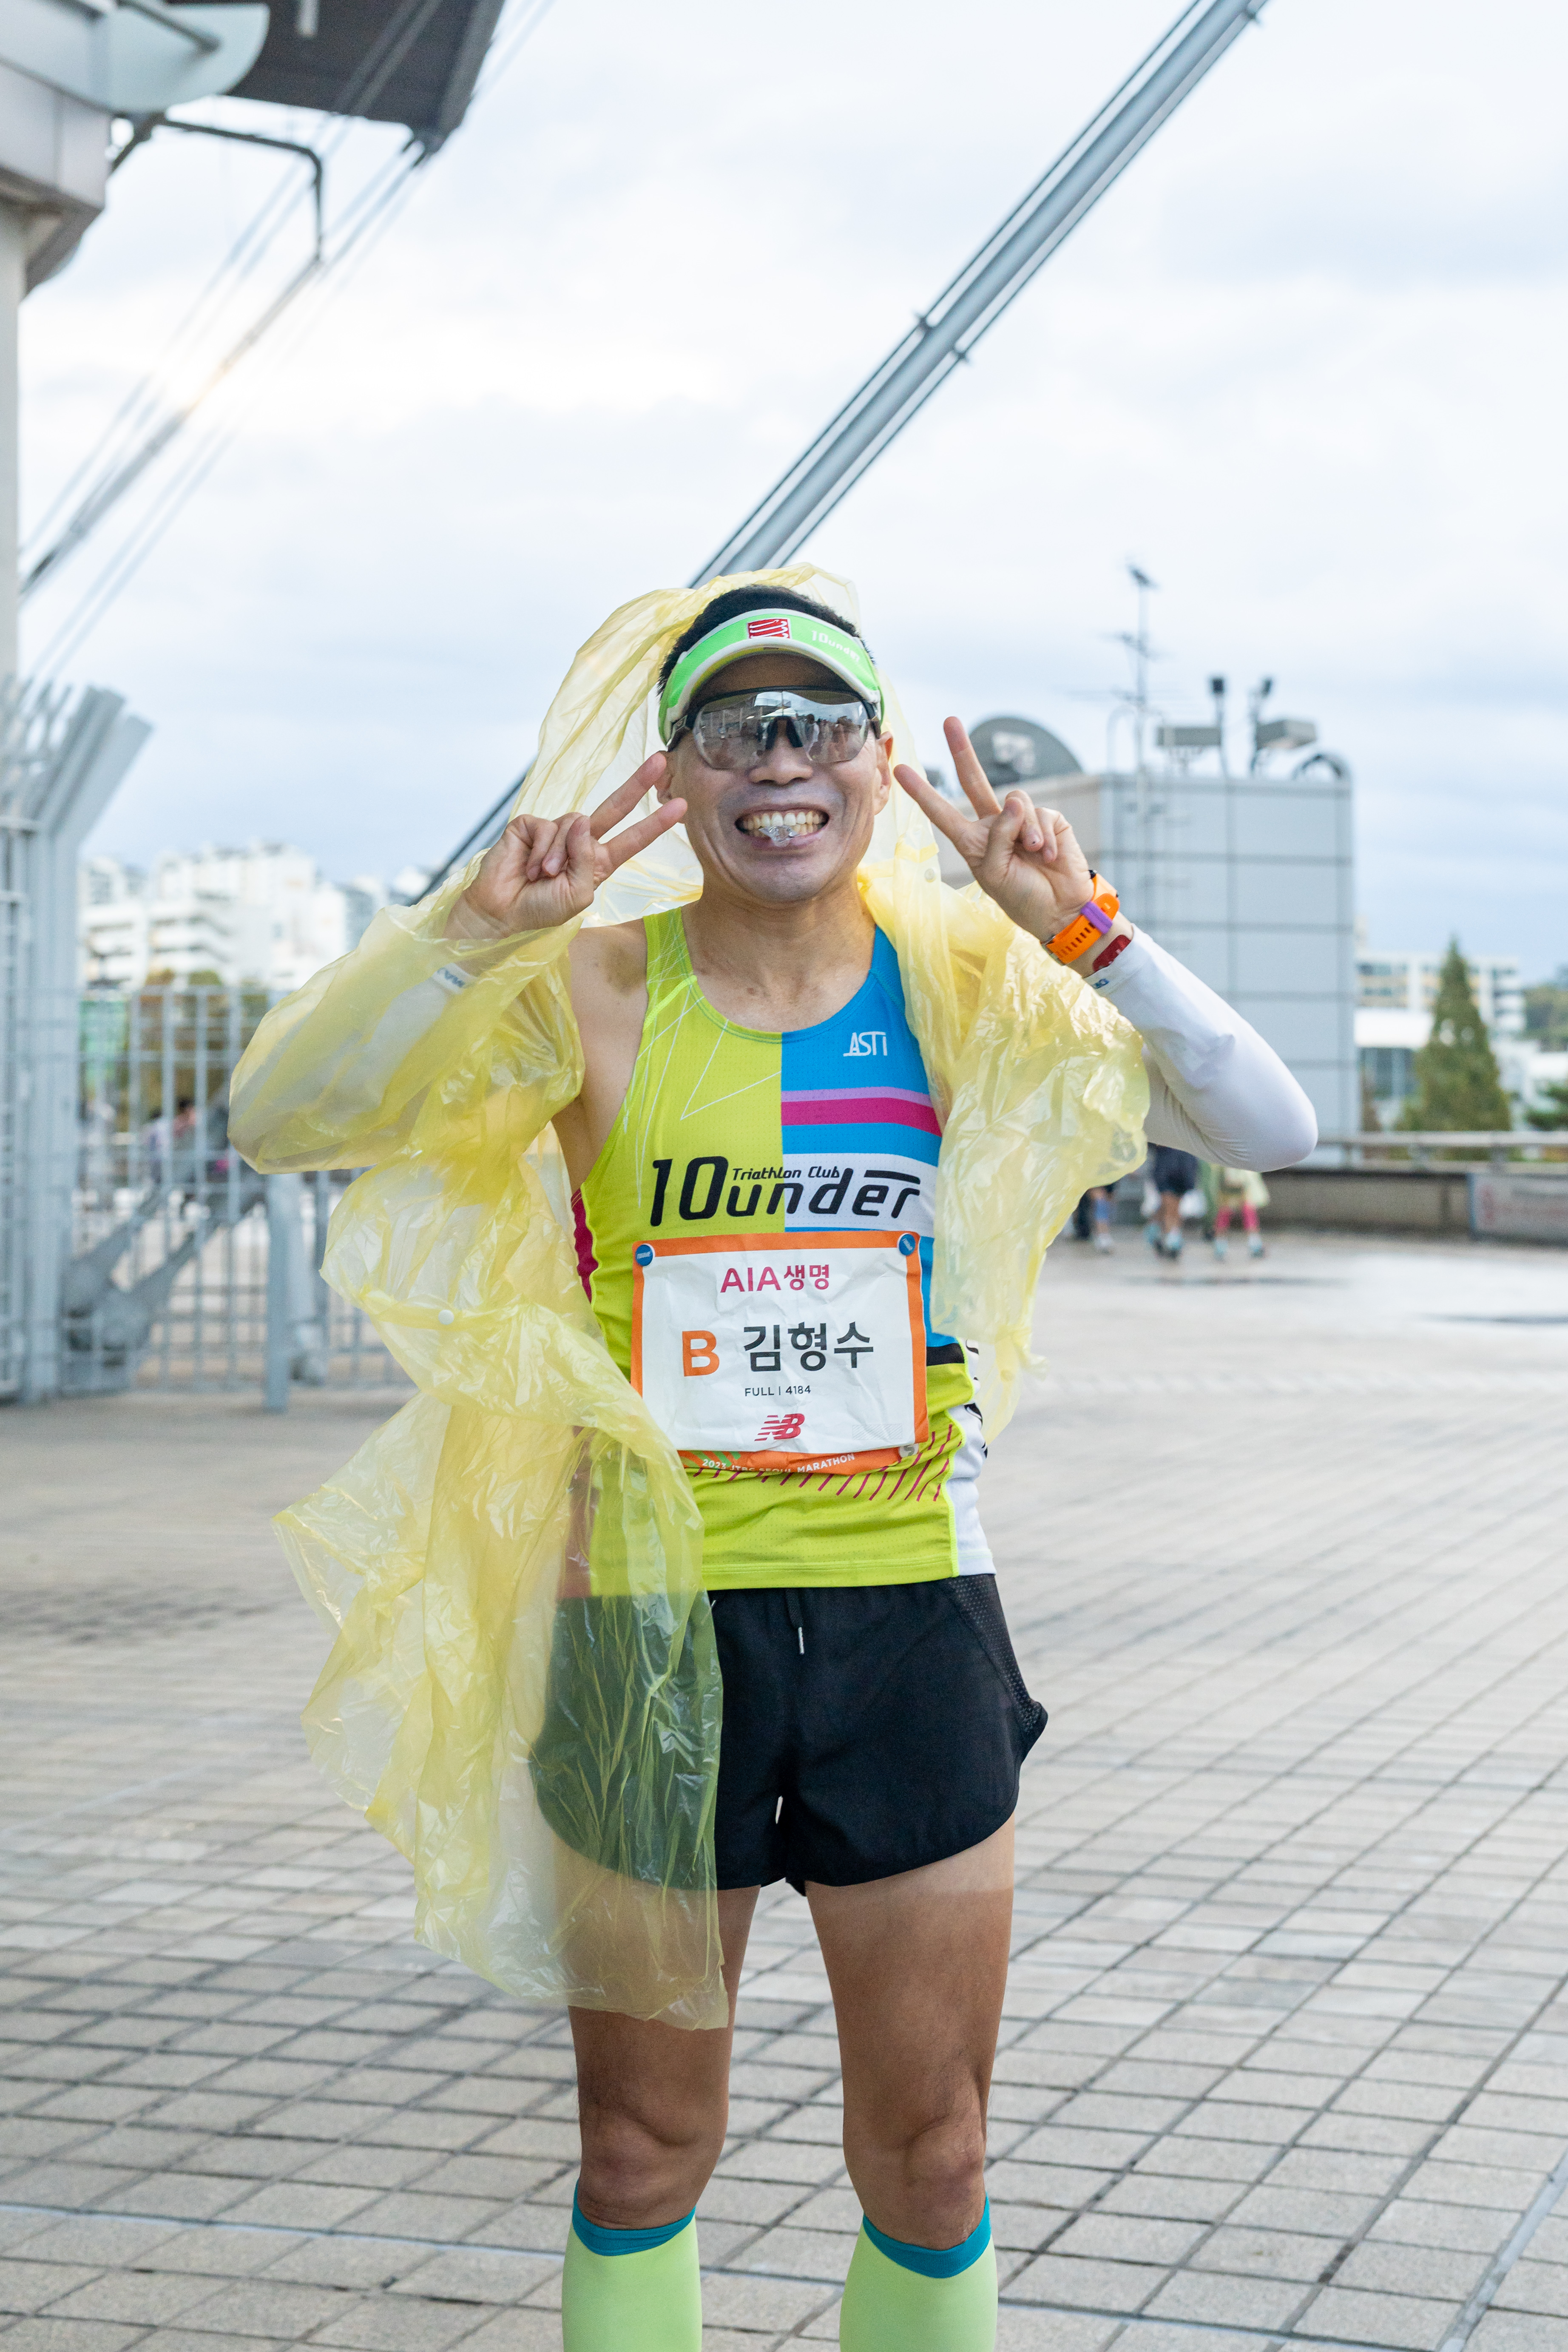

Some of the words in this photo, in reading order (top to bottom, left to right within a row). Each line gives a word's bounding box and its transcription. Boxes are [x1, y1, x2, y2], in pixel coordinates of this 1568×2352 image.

[843, 1031, 888, 1057] ASTI
[733, 1167, 801, 1181] Triathlon
[808, 1166, 841, 1178] Club
[682, 1330, 720, 1377] B
[743, 1321, 874, 1372] 김형수
[745, 1387, 774, 1396] FULL
[785, 1385, 811, 1395] 4184
[702, 1459, 726, 1470] 2023
[797, 1453, 855, 1472] MARATHON
